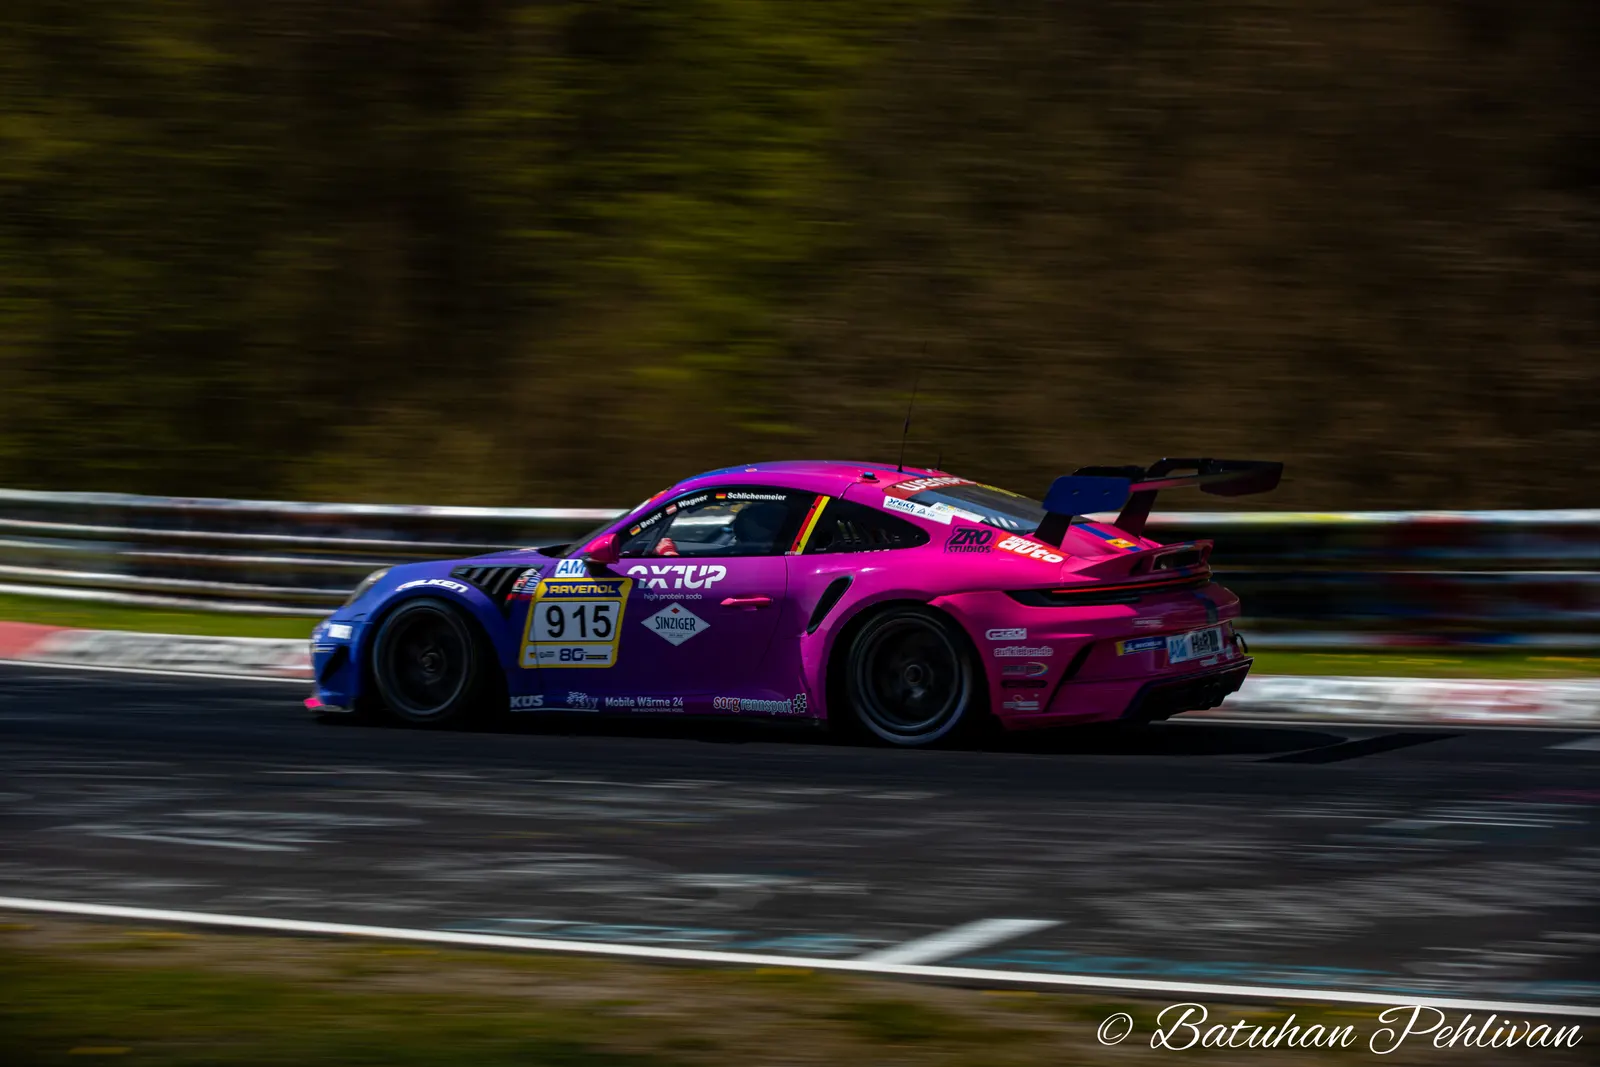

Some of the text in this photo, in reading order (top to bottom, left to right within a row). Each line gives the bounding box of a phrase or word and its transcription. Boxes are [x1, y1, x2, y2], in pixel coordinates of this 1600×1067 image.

[677, 495, 708, 508] Wagner
[727, 492, 787, 501] Schlichenmeier
[640, 512, 663, 529] Beyer
[949, 528, 993, 545] ZRO
[948, 545, 991, 553] STUDIOS
[557, 560, 587, 574] AM
[549, 585, 616, 594] RAVENOL
[643, 593, 659, 602] high
[659, 593, 685, 602] protein
[546, 605, 611, 638] 915
[655, 616, 696, 631] SINZIGER
[605, 696, 635, 707] Mobile
[637, 696, 670, 707] Wärme
[672, 697, 684, 707] 24
